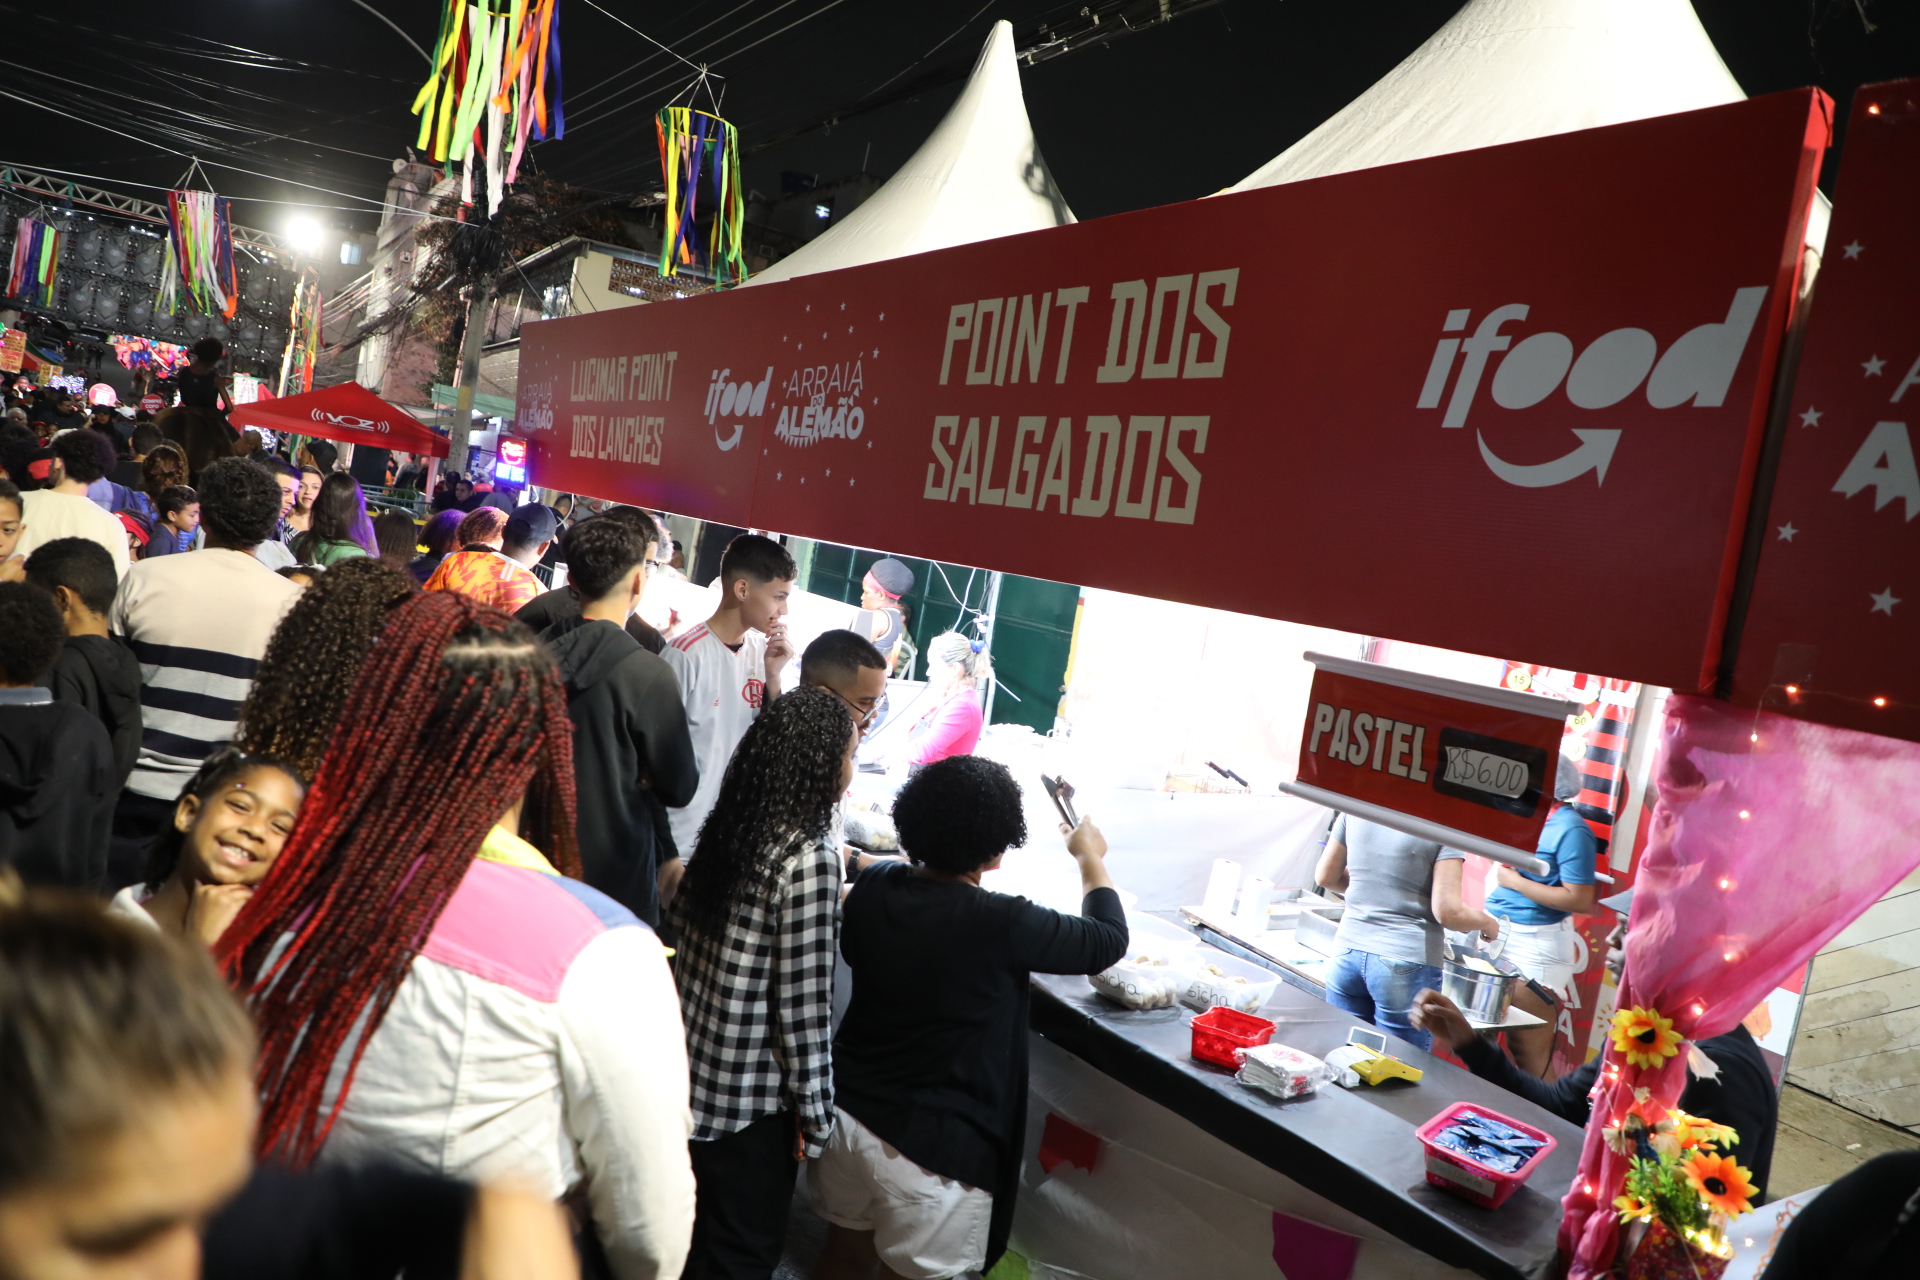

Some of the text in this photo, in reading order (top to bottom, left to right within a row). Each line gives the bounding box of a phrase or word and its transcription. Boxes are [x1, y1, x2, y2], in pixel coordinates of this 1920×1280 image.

[939, 267, 1240, 387] POINT DOS
[570, 351, 678, 402] LUCIMAR POINT
[786, 352, 864, 399] ARRAIÁ
[1416, 286, 1769, 428] ifood
[704, 366, 774, 425] ifood
[774, 397, 865, 441] ALEMÃO
[812, 395, 823, 407] DO
[570, 415, 664, 466] DOS LANCHES
[923, 415, 1211, 525] SALGADOS
[1513, 675, 1525, 686] 15
[1309, 702, 1429, 783] PASTEL
